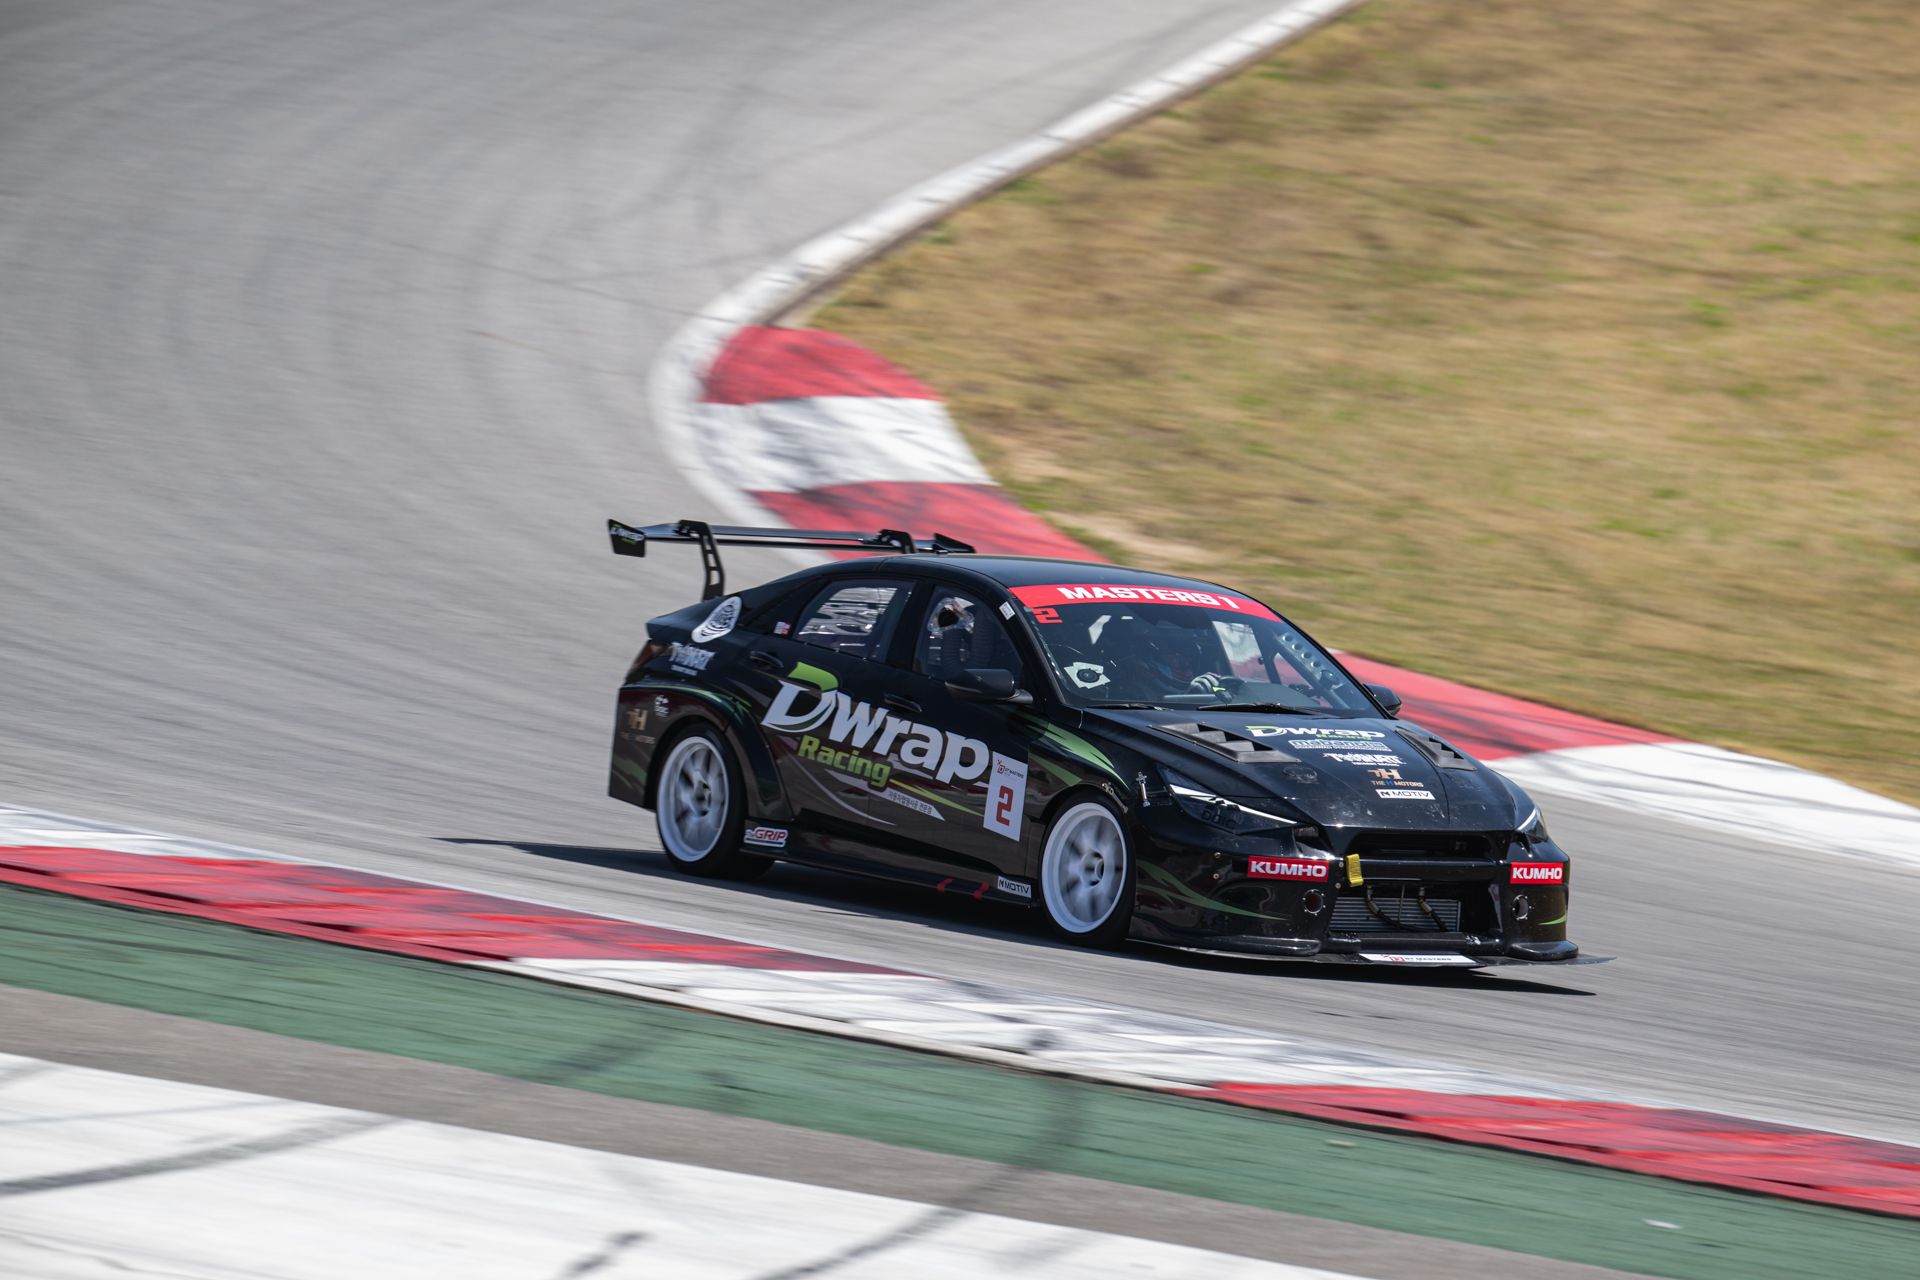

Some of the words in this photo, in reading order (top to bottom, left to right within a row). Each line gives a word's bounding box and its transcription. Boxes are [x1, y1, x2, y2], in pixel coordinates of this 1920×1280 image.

[1057, 587, 1217, 606] MASTERS
[1217, 596, 1240, 609] 1
[1031, 608, 1063, 624] 2
[760, 661, 990, 784] Dwrap
[1244, 725, 1386, 739] Dwrap
[798, 735, 891, 787] Racing
[995, 785, 1014, 827] 2
[1250, 860, 1328, 878] KUMHO
[1512, 866, 1563, 880] KUMHO
